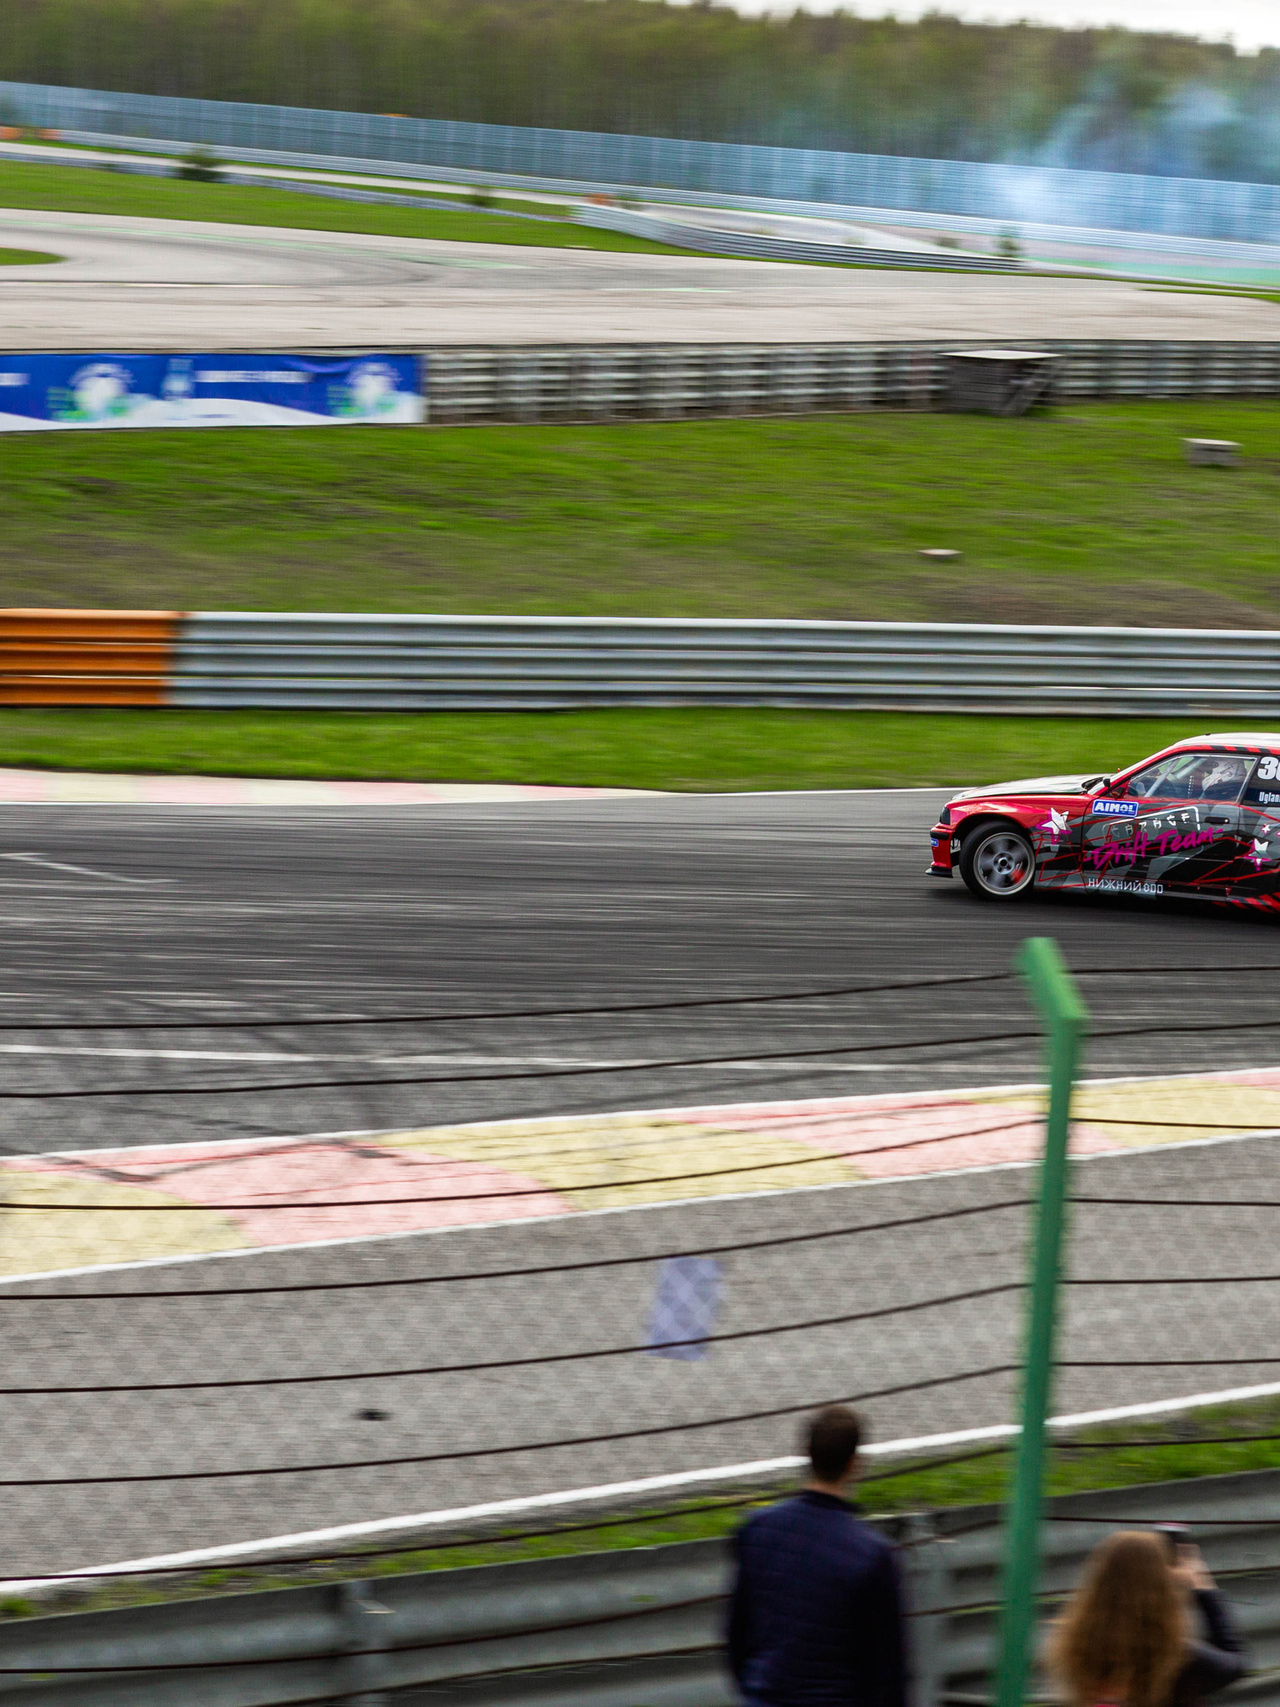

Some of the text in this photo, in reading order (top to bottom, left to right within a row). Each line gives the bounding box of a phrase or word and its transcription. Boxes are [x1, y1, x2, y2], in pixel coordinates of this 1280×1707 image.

[1094, 801, 1136, 814] AIMOL
[1090, 830, 1152, 870] Drift
[1088, 877, 1142, 892] НИЖНИЙ
